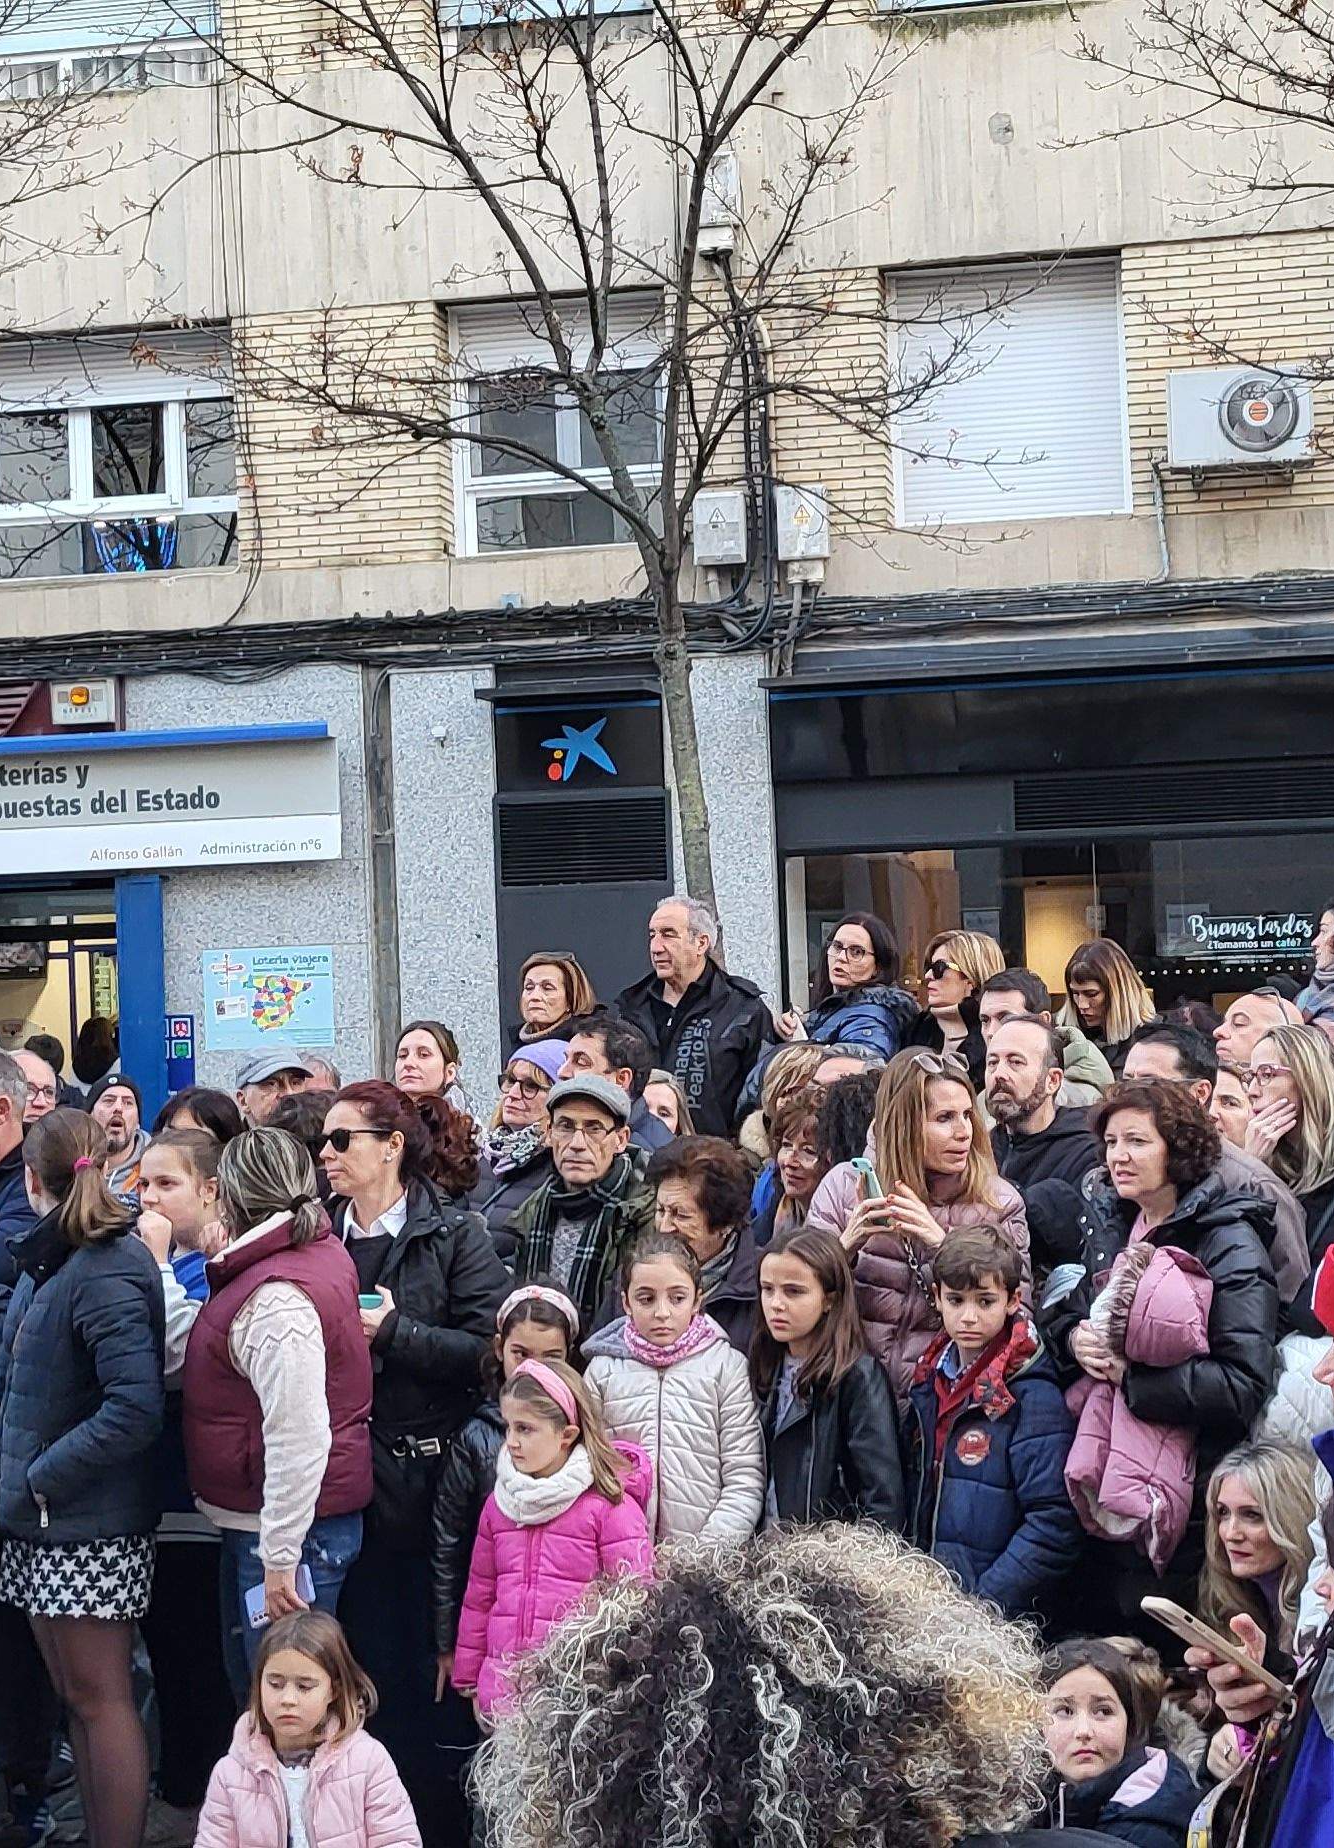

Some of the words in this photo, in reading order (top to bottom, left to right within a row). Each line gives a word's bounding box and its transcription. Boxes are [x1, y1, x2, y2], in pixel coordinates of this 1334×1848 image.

[76, 764, 90, 789] y
[90, 789, 128, 815] del
[136, 785, 221, 812] Estado
[90, 847, 139, 862] Alfonso
[142, 844, 183, 860] Gallán
[200, 841, 296, 857] Administración
[1187, 914, 1257, 942] Buenas
[1254, 912, 1313, 938] tardes
[1207, 940, 1258, 950] ¿Tomamos
[1261, 940, 1273, 948] un
[1276, 937, 1301, 948] café?
